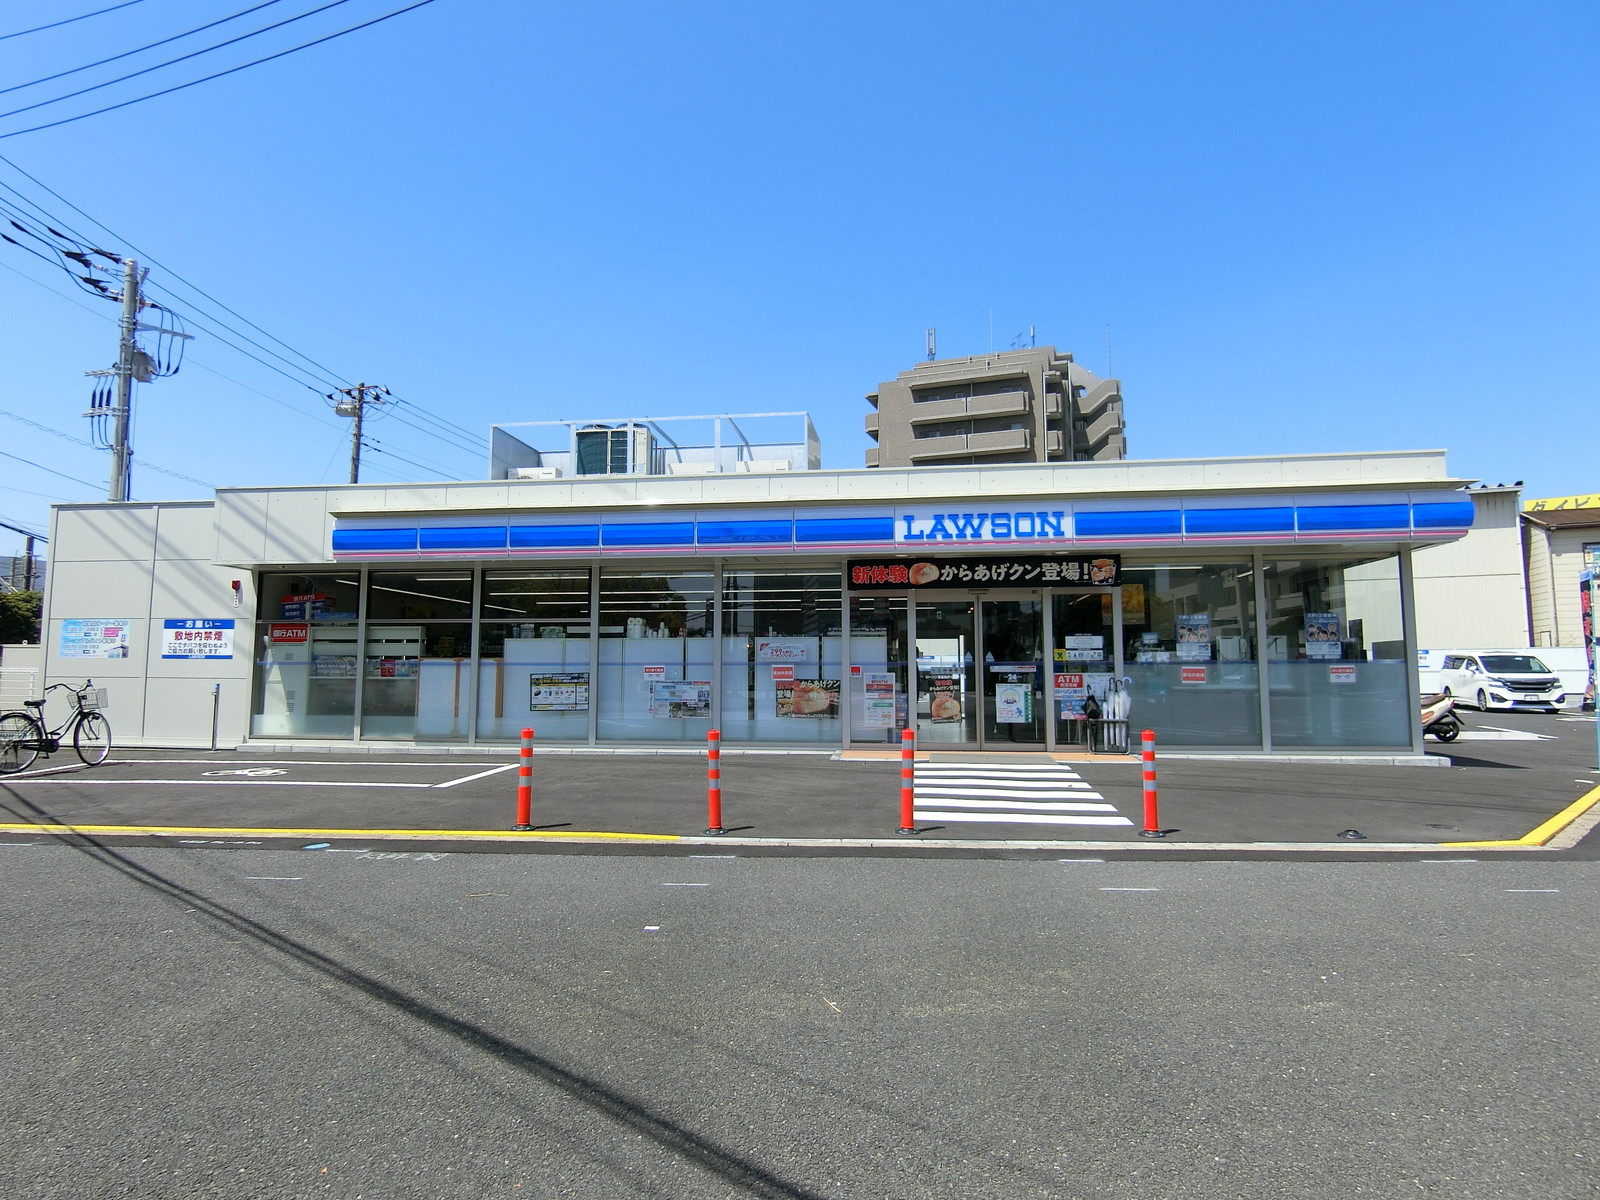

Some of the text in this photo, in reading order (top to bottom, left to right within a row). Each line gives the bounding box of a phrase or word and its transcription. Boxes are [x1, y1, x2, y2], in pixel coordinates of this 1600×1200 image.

[903, 511, 1064, 540] LAWSON
[851, 562, 1089, 584] 新体験 からあげクン登場!
[174, 631, 223, 641] 敷地内禁煙
[273, 629, 306, 637] 銀行ATM
[1057, 675, 1080, 683] ATM
[800, 680, 840, 688] からあげクン
